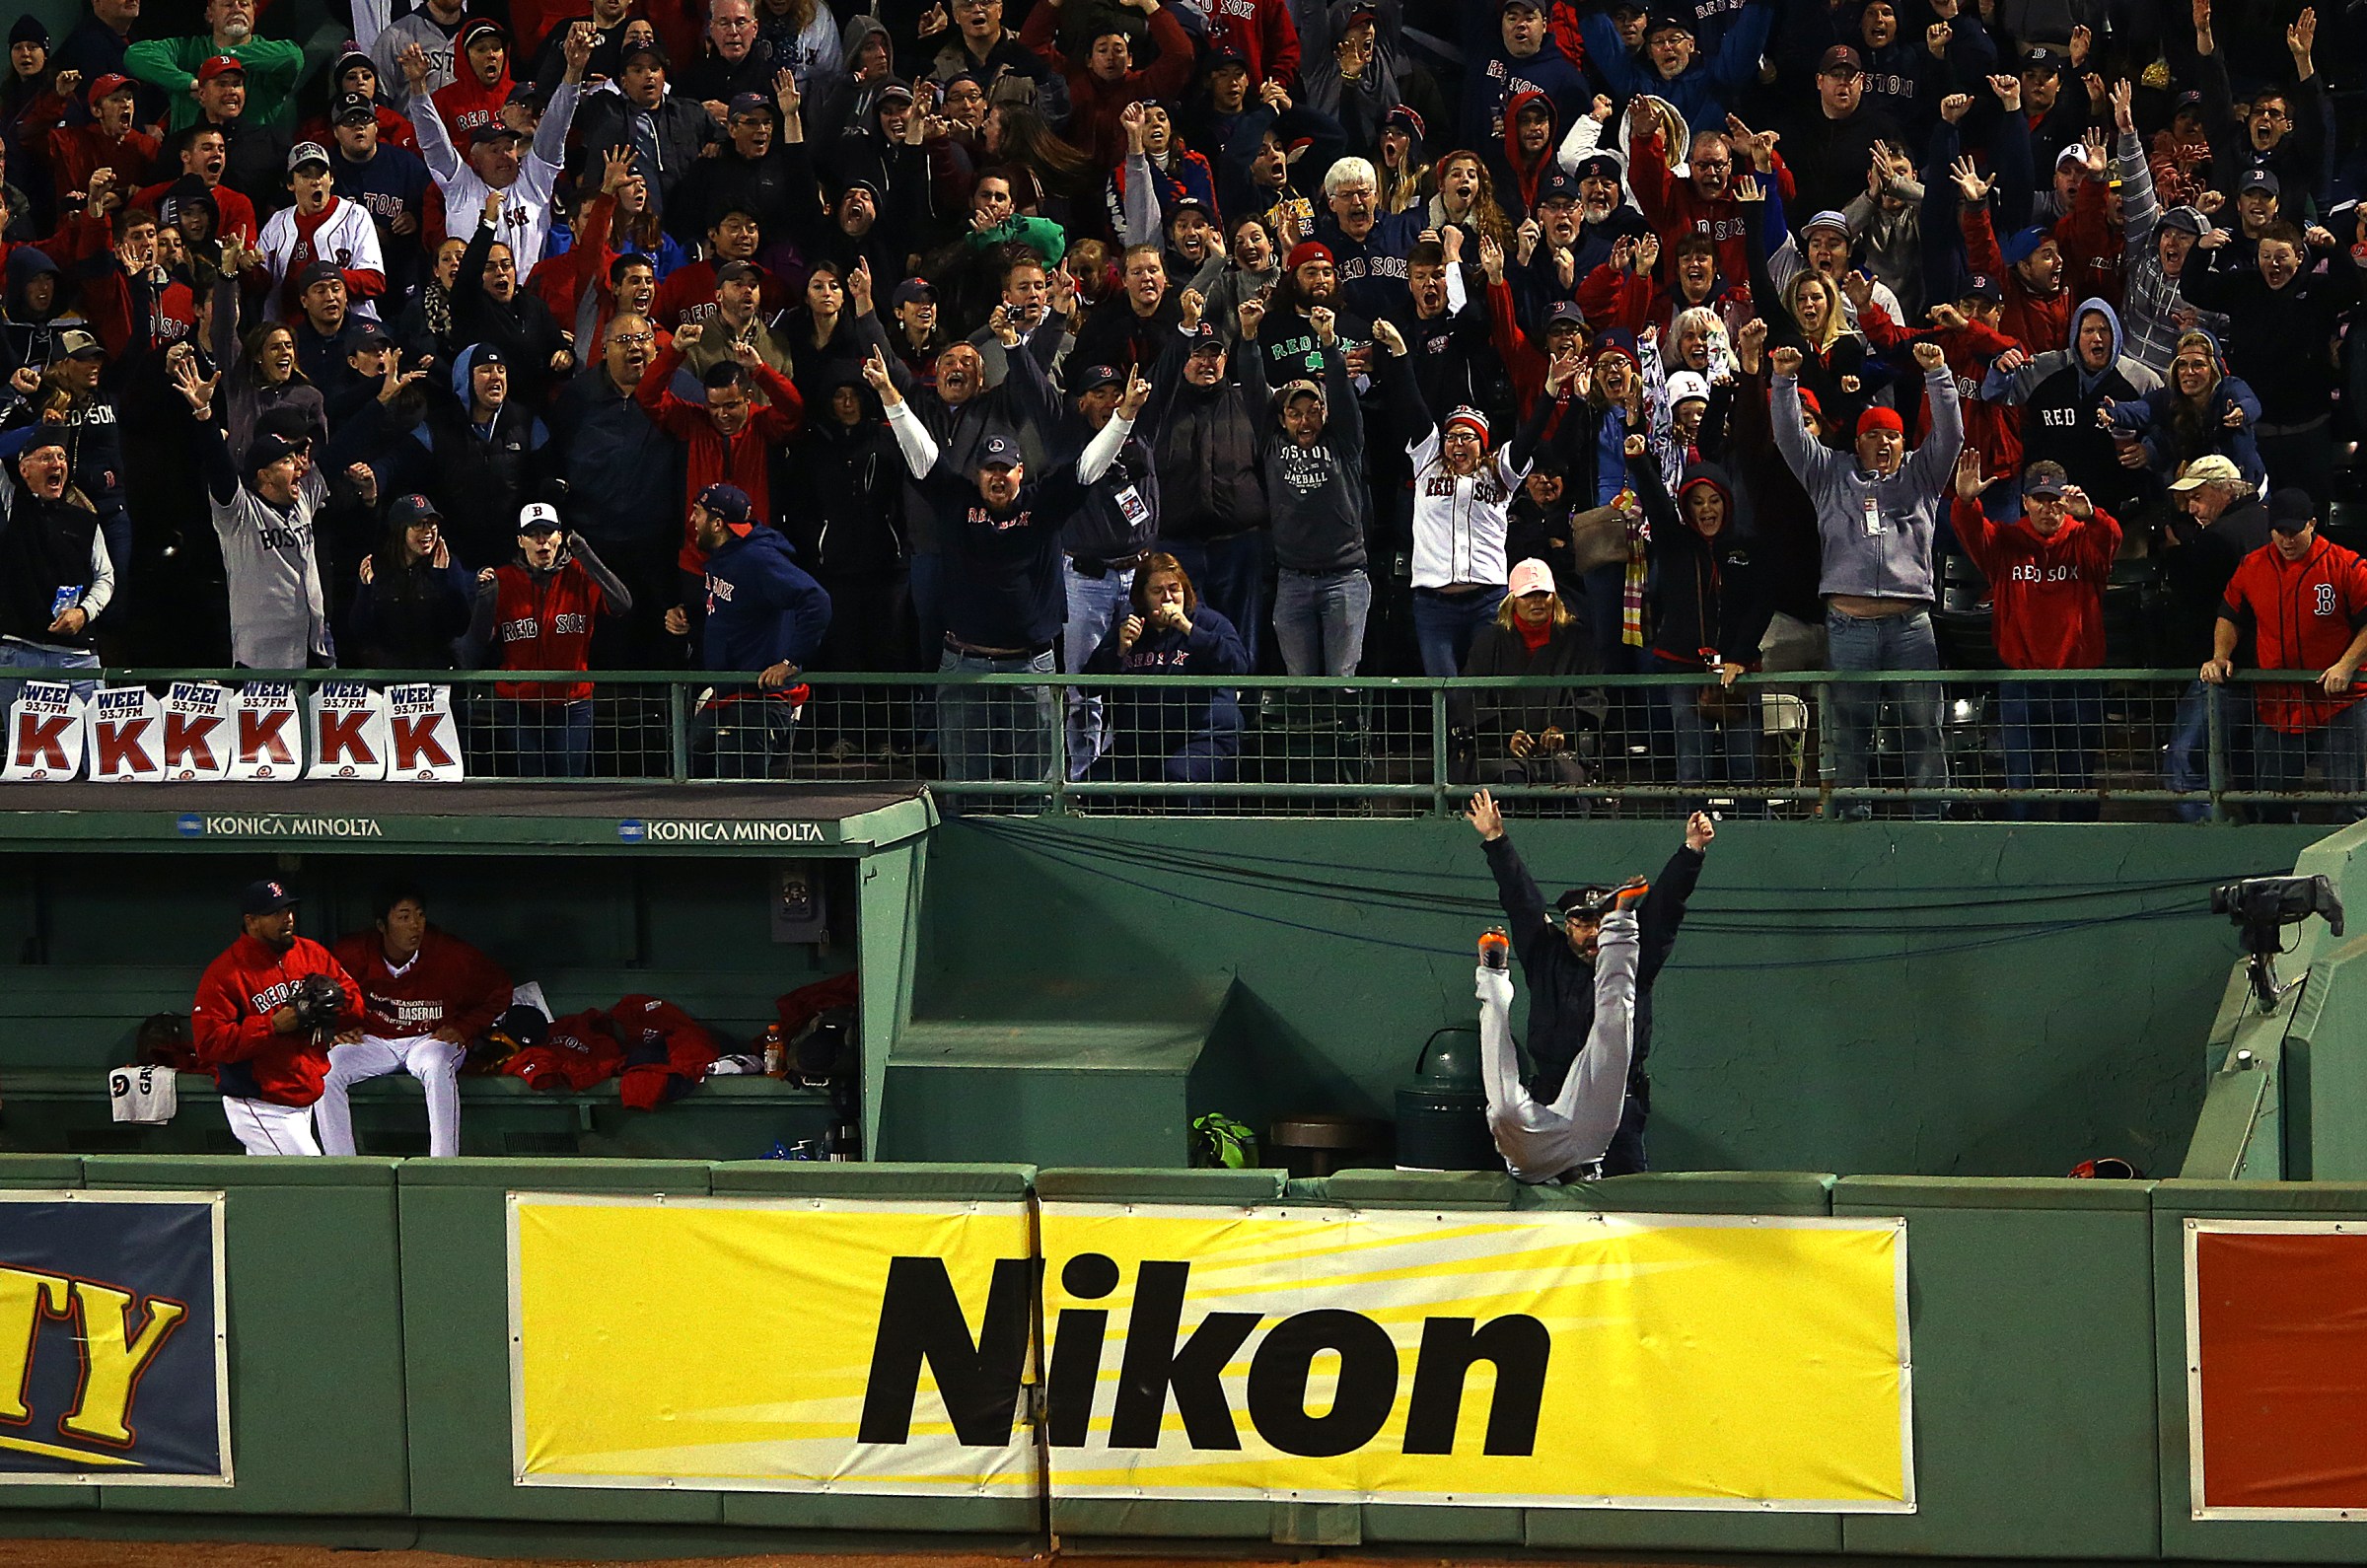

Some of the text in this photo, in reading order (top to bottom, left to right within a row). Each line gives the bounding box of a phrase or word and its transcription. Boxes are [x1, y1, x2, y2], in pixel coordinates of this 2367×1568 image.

[1220, 0, 1255, 20] SOX
[1864, 73, 1913, 98] STON
[457, 109, 489, 131] RED
[2254, 170, 2264, 180] B
[364, 192, 402, 217] TON
[1715, 217, 1746, 241] SOX
[1371, 256, 1408, 283] SOX
[1200, 322, 1213, 336] B
[1271, 335, 1312, 360] RED
[1959, 377, 1981, 400] OX
[2042, 408, 2075, 427] RED
[1425, 477, 1455, 497] RED
[533, 506, 542, 517] B
[2012, 565, 2078, 583] RED SOX
[2313, 583, 2336, 615] B
[502, 613, 587, 642] RED SOX
[98, 689, 145, 709] WEEI
[172, 683, 222, 704] WEEI
[243, 680, 292, 697] WEEI
[322, 681, 369, 697] WEEI
[15, 712, 77, 770] K
[96, 717, 158, 775] K
[165, 712, 226, 771] K
[238, 709, 296, 764] K
[318, 709, 379, 764] K
[391, 712, 456, 770] K
[206, 817, 383, 836] KONICA MINOLTA
[647, 821, 825, 841] KONICA MINOLTA
[252, 982, 291, 1014] RED
[398, 1006, 443, 1021] BASEBALL
[857, 1252, 1551, 1458] Nikon
